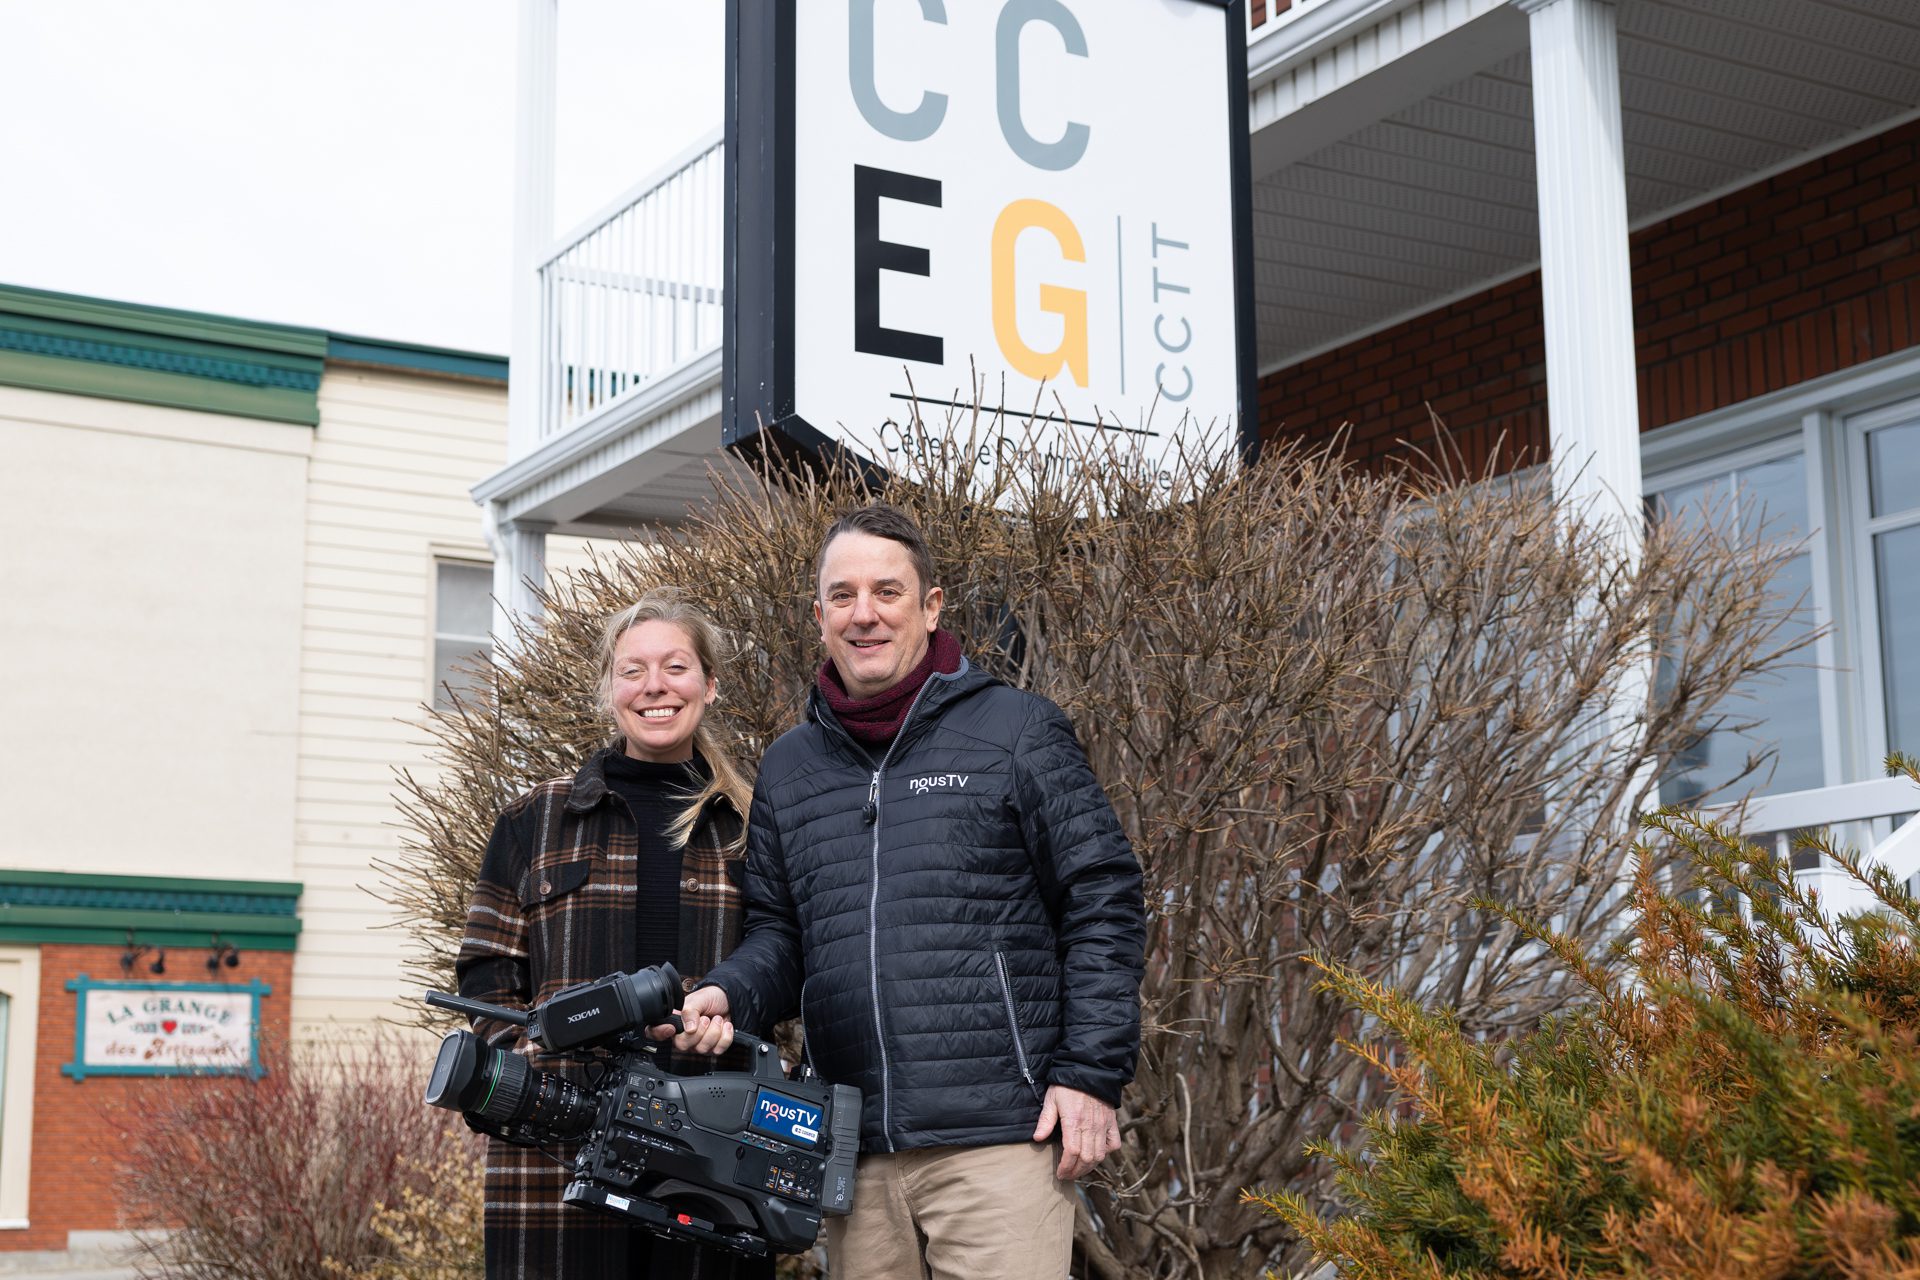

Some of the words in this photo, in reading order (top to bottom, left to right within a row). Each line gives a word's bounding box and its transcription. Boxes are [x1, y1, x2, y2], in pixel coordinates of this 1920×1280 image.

[1151, 222, 1194, 402] CCTT
[106, 1005, 134, 1025] LA
[143, 998, 232, 1025] GRANGE
[567, 1007, 601, 1024] XDCAM
[105, 1040, 137, 1057] des
